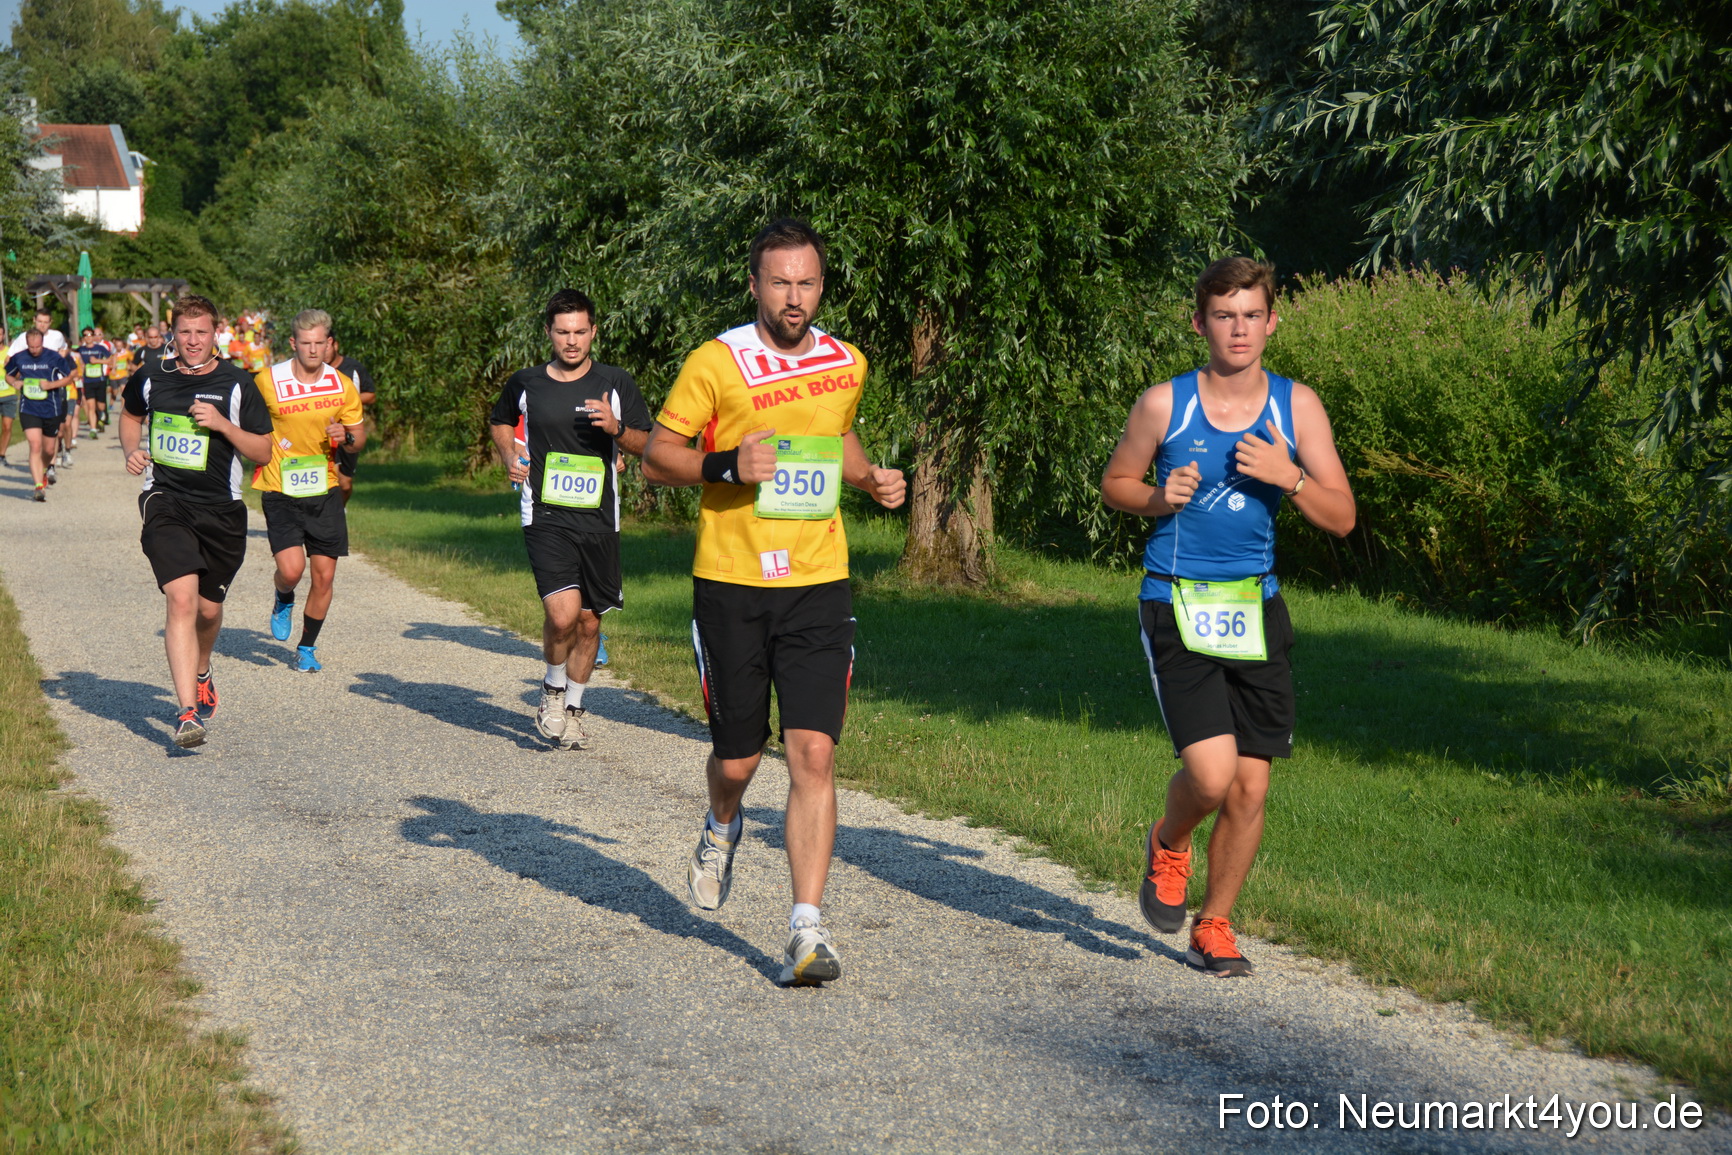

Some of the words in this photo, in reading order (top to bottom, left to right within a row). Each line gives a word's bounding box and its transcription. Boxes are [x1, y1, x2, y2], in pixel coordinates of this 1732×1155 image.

[752, 386, 803, 411] MAX
[807, 373, 859, 397] BÖGL
[278, 402, 311, 415] MAX
[314, 397, 346, 410] BÖGL
[157, 434, 202, 456] 1082
[290, 471, 319, 486] 945
[551, 474, 597, 494] 1090
[774, 469, 825, 496] 950
[1198, 487, 1218, 505] Team
[1194, 611, 1246, 637] 856
